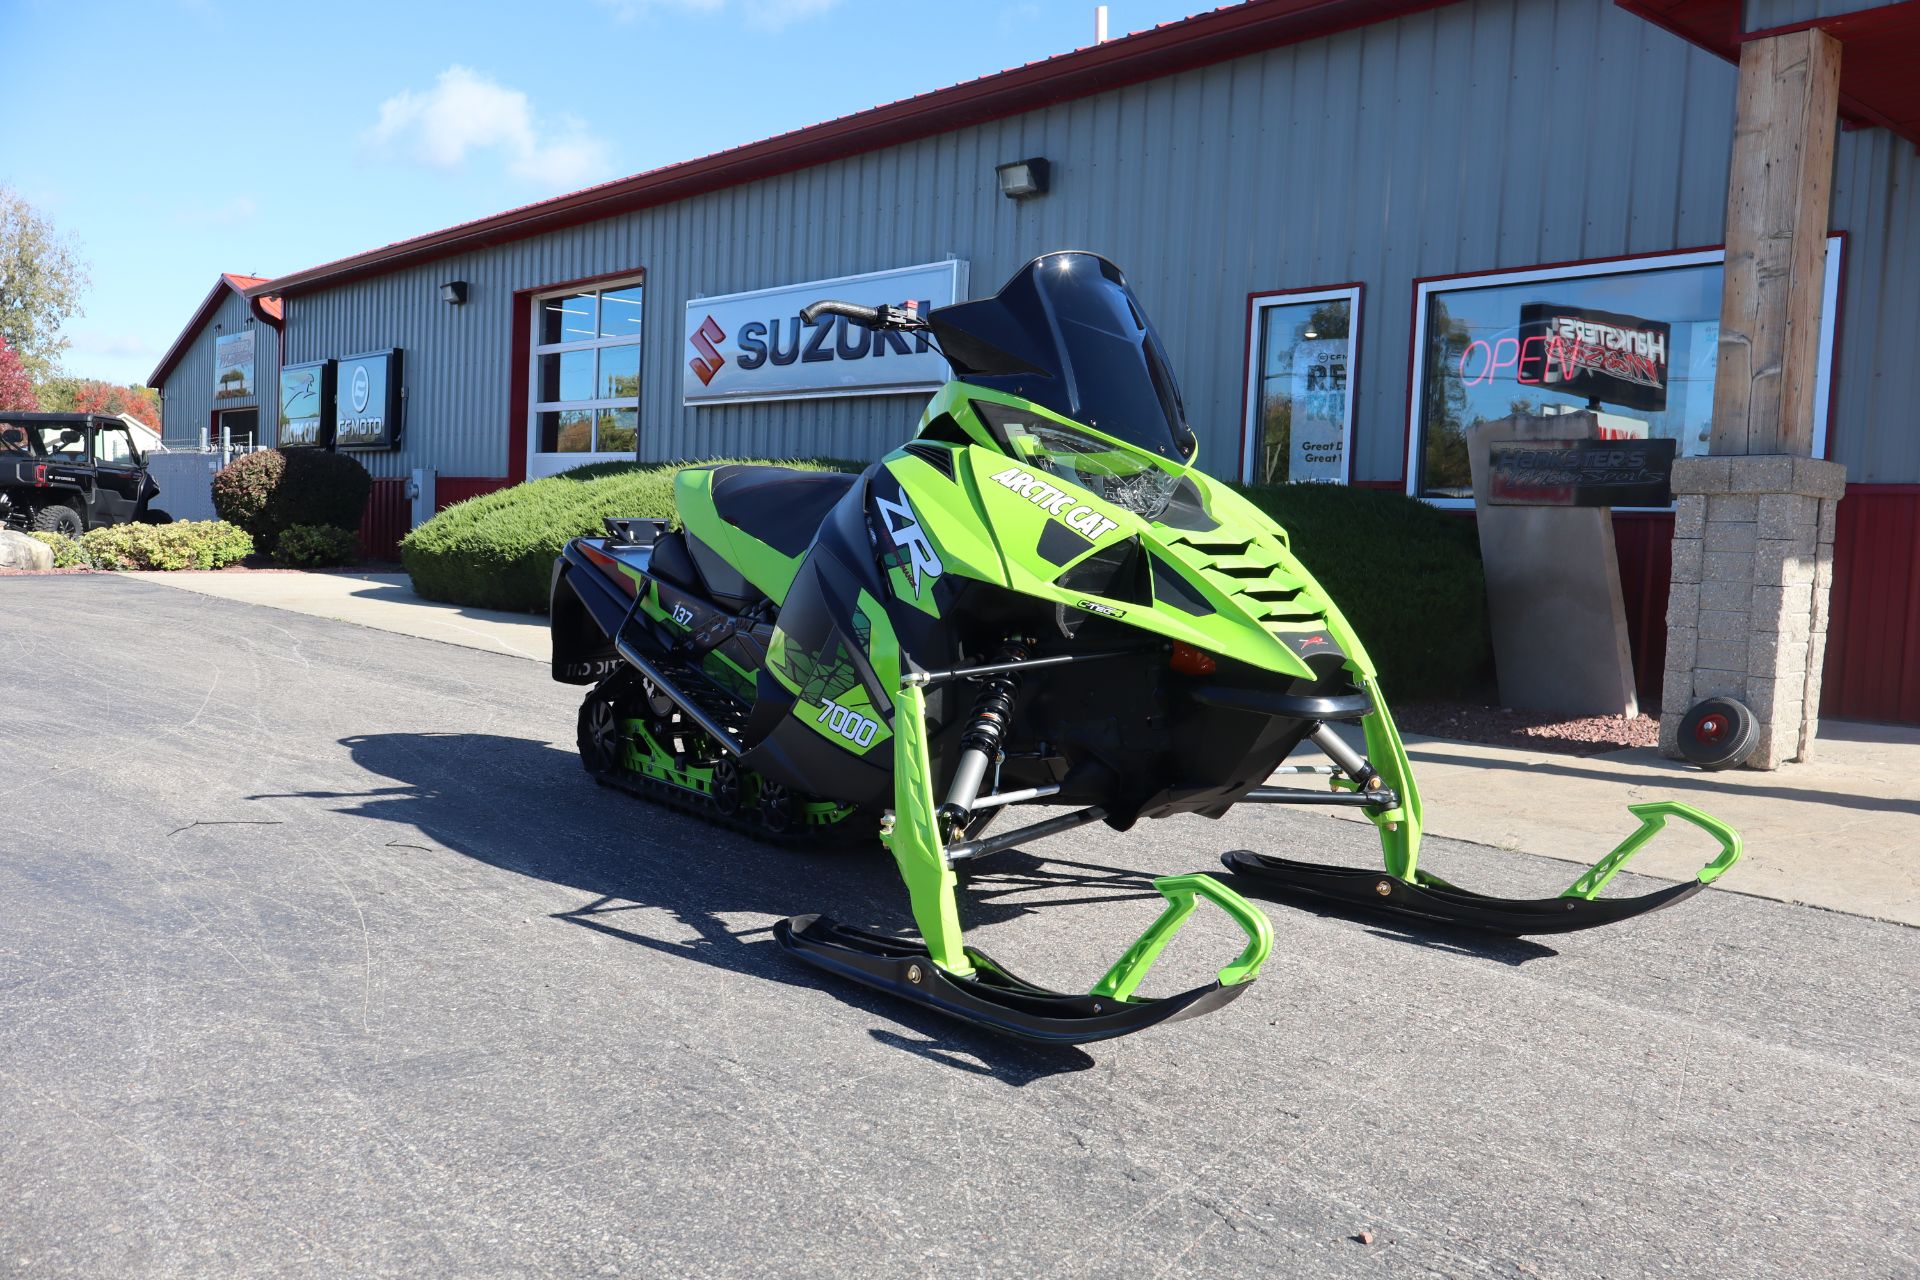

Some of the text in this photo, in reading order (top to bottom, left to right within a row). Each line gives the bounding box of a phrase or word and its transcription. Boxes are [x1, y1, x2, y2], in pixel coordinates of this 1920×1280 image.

[736, 299, 931, 370] SUZUKI
[1459, 335, 1581, 386] OPEN
[281, 421, 318, 443] ARCTIC CAT
[338, 416, 383, 438] CFMOTO
[1302, 441, 1334, 451] Great
[1305, 453, 1337, 463] Great
[989, 467, 1119, 541] ARCTIC CAT
[875, 485, 944, 601] ZR
[672, 604, 694, 626] 137
[817, 697, 878, 747] 7000
